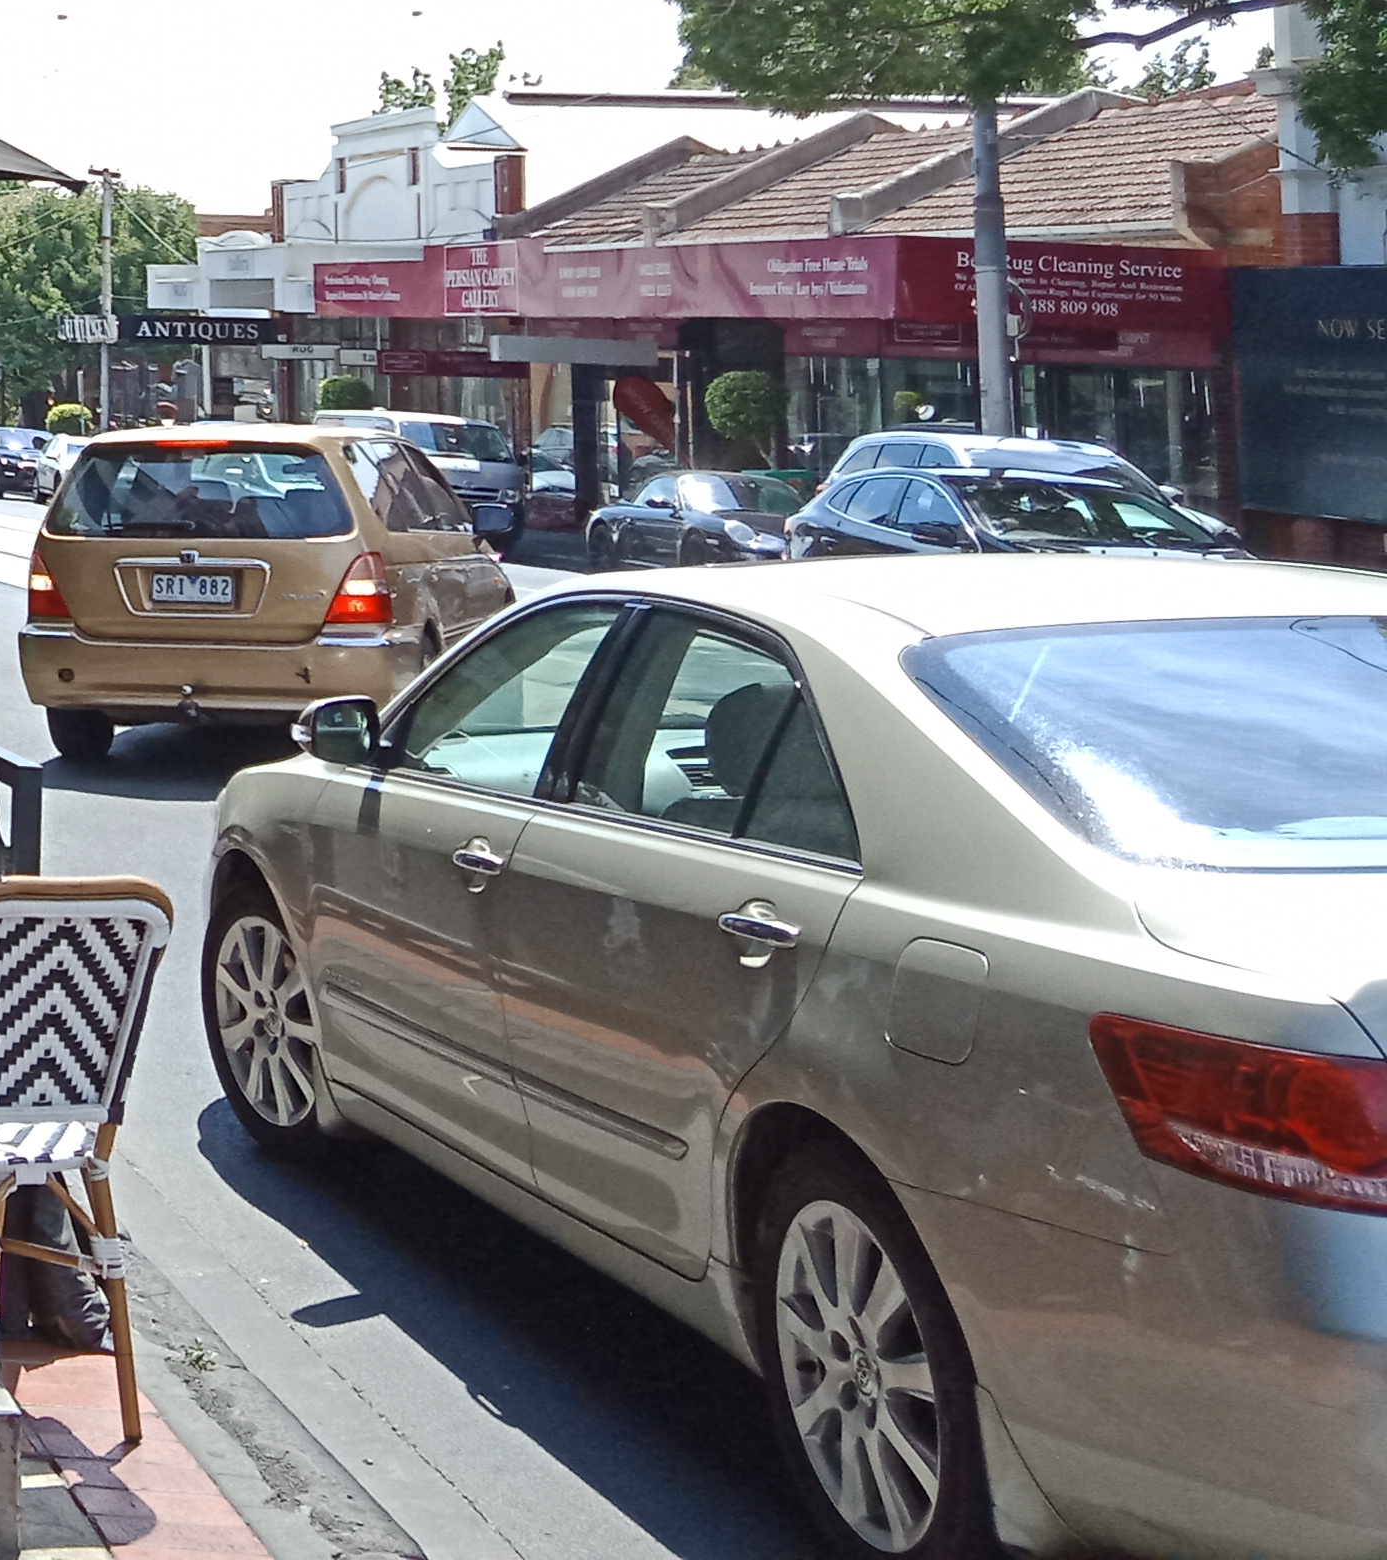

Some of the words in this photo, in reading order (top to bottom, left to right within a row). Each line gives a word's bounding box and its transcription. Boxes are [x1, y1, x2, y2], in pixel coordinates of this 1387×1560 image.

[1038, 255, 1114, 279] Cleaning
[1119, 259, 1183, 279] Service
[1060, 299, 1088, 315] 809
[1091, 301, 1119, 317] 908
[136, 321, 260, 340] ANTIQUES
[1318, 319, 1357, 338] NOW
[155, 577, 184, 596] SRI
[199, 578, 230, 596] 882
